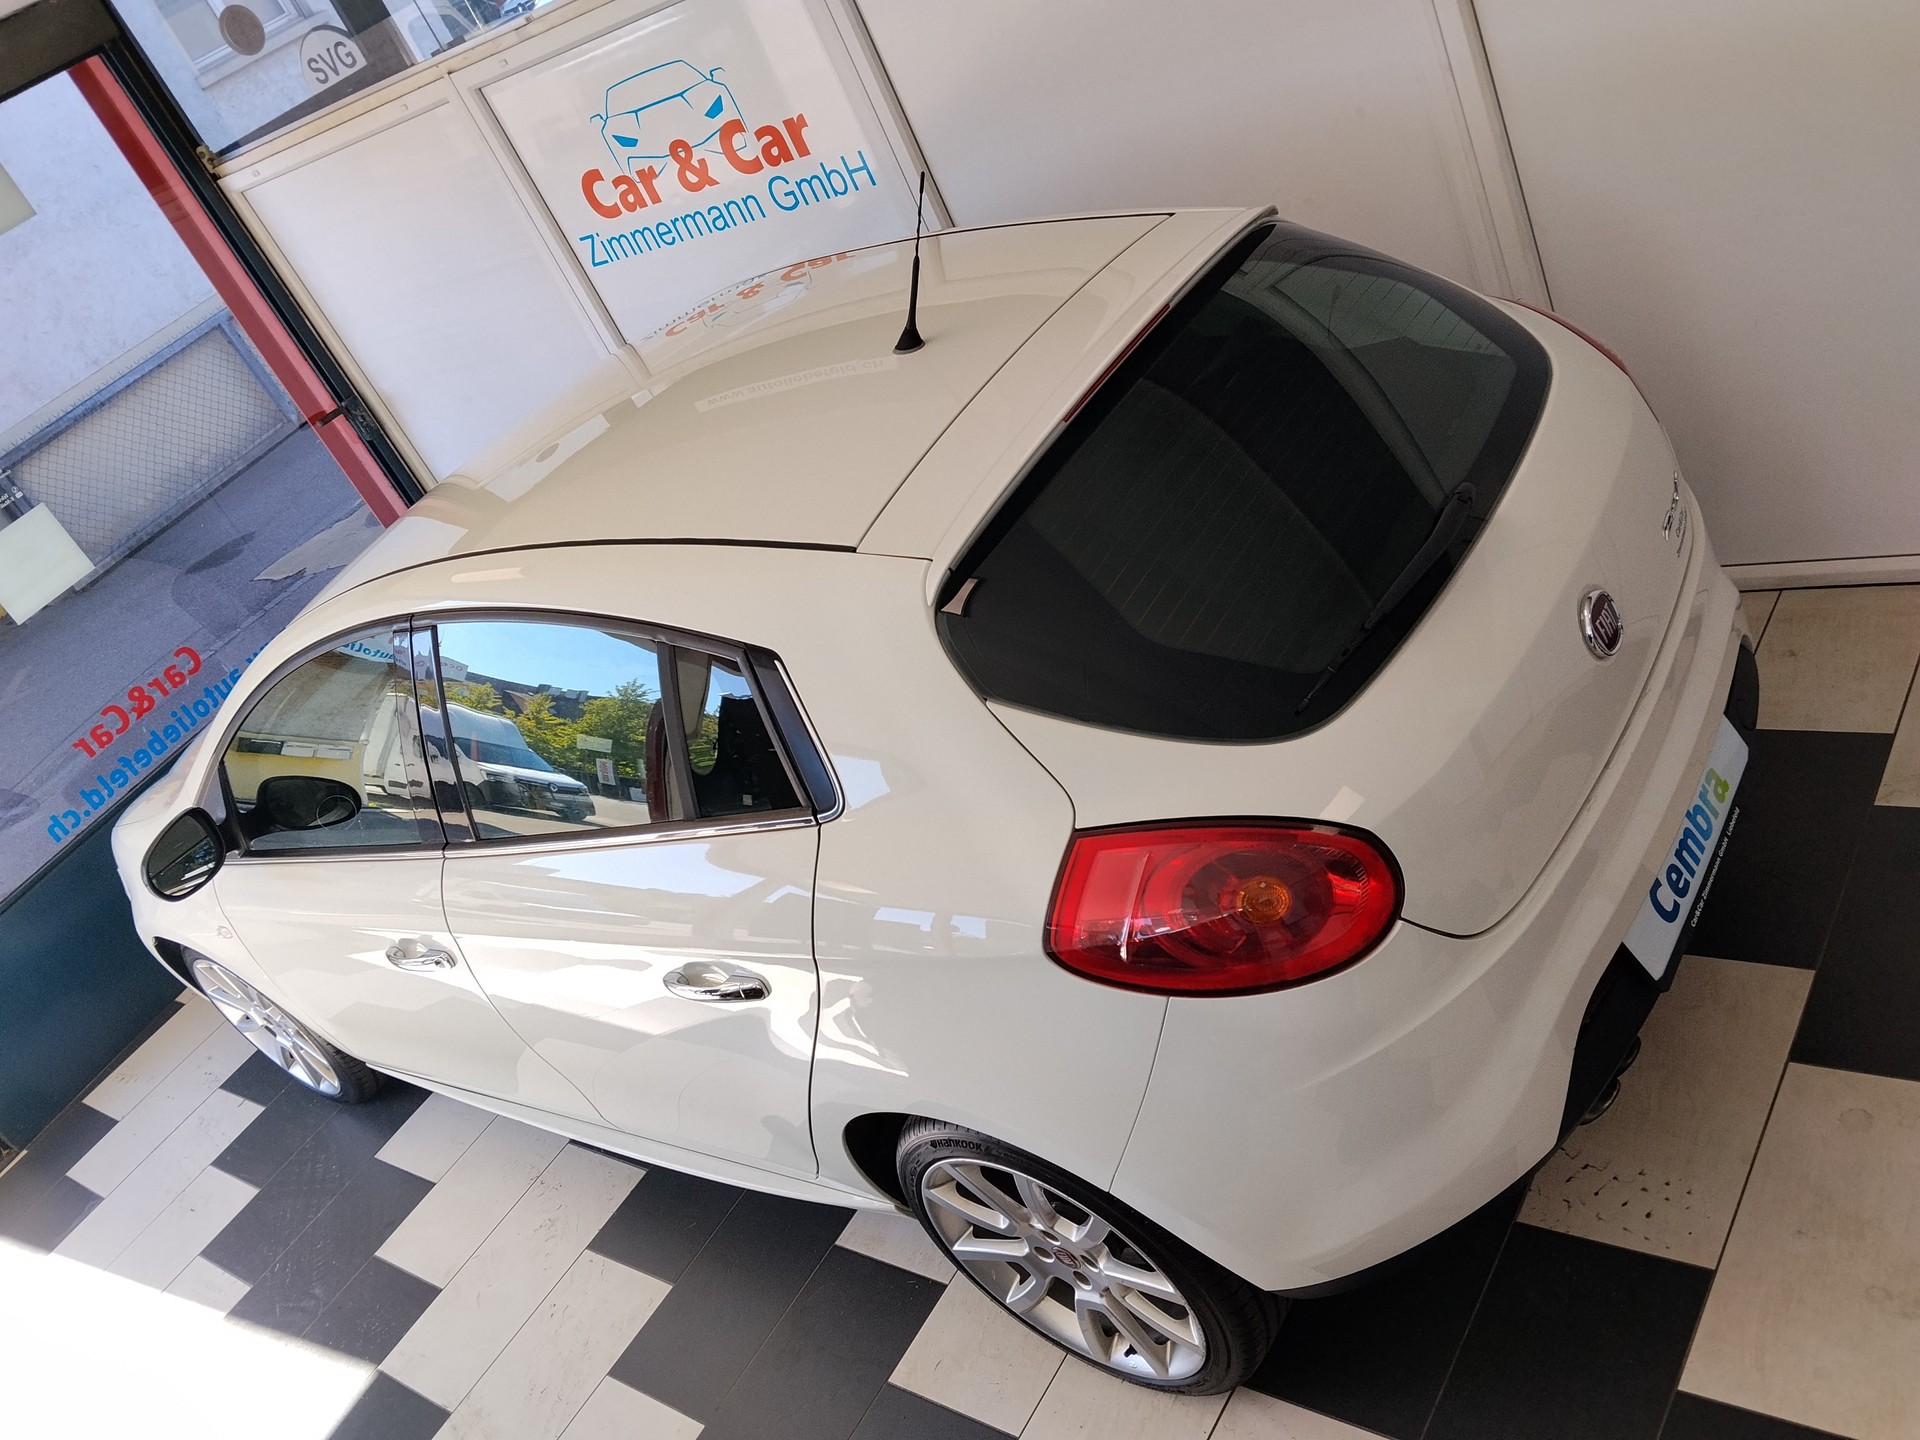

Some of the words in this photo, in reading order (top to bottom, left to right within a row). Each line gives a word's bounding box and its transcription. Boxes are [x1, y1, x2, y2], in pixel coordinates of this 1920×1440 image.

[307, 41, 357, 85] SVG
[578, 192, 766, 268] Zimmermann
[768, 150, 878, 212] GmbH
[580, 161, 663, 220] Car
[668, 138, 720, 193] &
[718, 112, 814, 176] Car
[1594, 601, 1618, 644] FIAT
[1649, 767, 1731, 924] Cembra
[1690, 898, 1706, 927] Car&Car
[1703, 857, 1721, 901] Zimmermann
[1718, 837, 1729, 857] GmbH
[1726, 806, 1740, 836] Liebefeld
